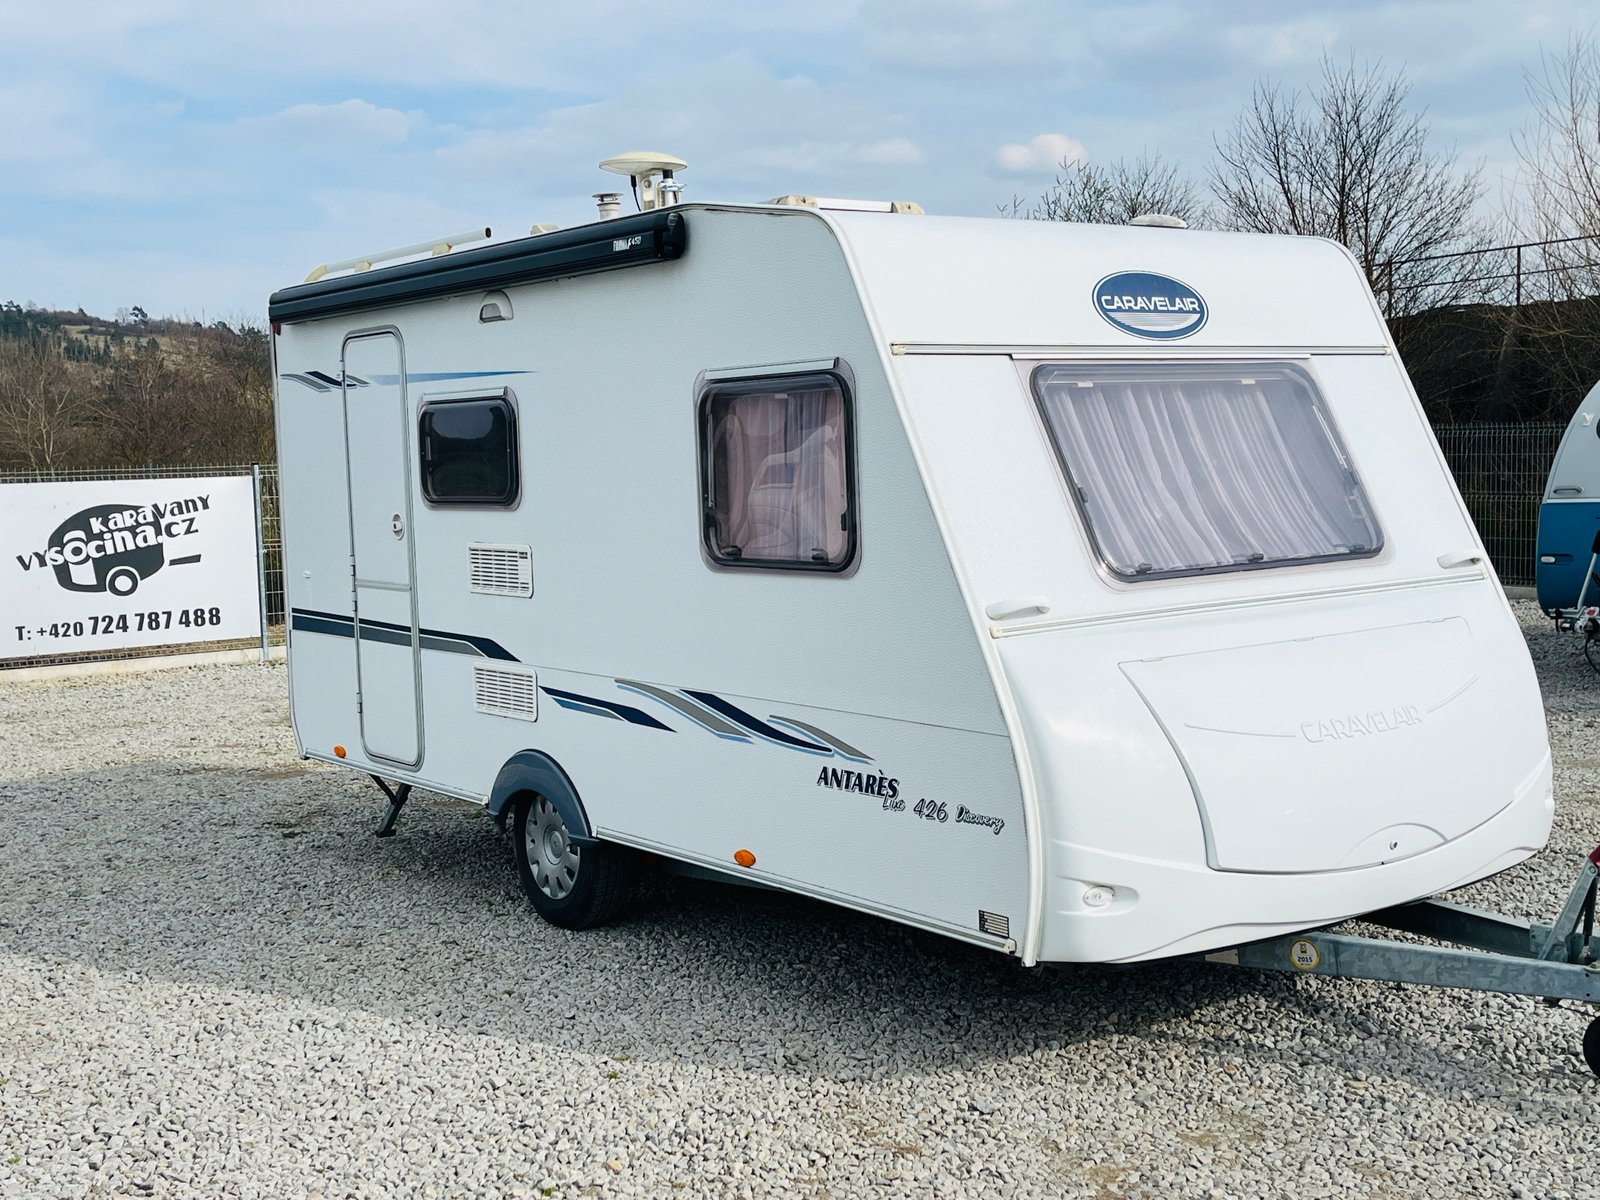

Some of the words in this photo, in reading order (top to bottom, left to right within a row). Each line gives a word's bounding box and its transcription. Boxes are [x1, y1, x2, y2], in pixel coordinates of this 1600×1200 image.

[1100, 295, 1201, 311] CARAVELAIR
[15, 625, 32, 641] T:
[36, 621, 84, 640] +420
[88, 614, 129, 635] 724
[134, 610, 172, 632] 787
[178, 606, 222, 628] 488
[1300, 704, 1423, 743] CARAVELAIR
[816, 766, 900, 799] ANTARÈS
[912, 798, 948, 823] 426
[954, 804, 1005, 836] Discovery
